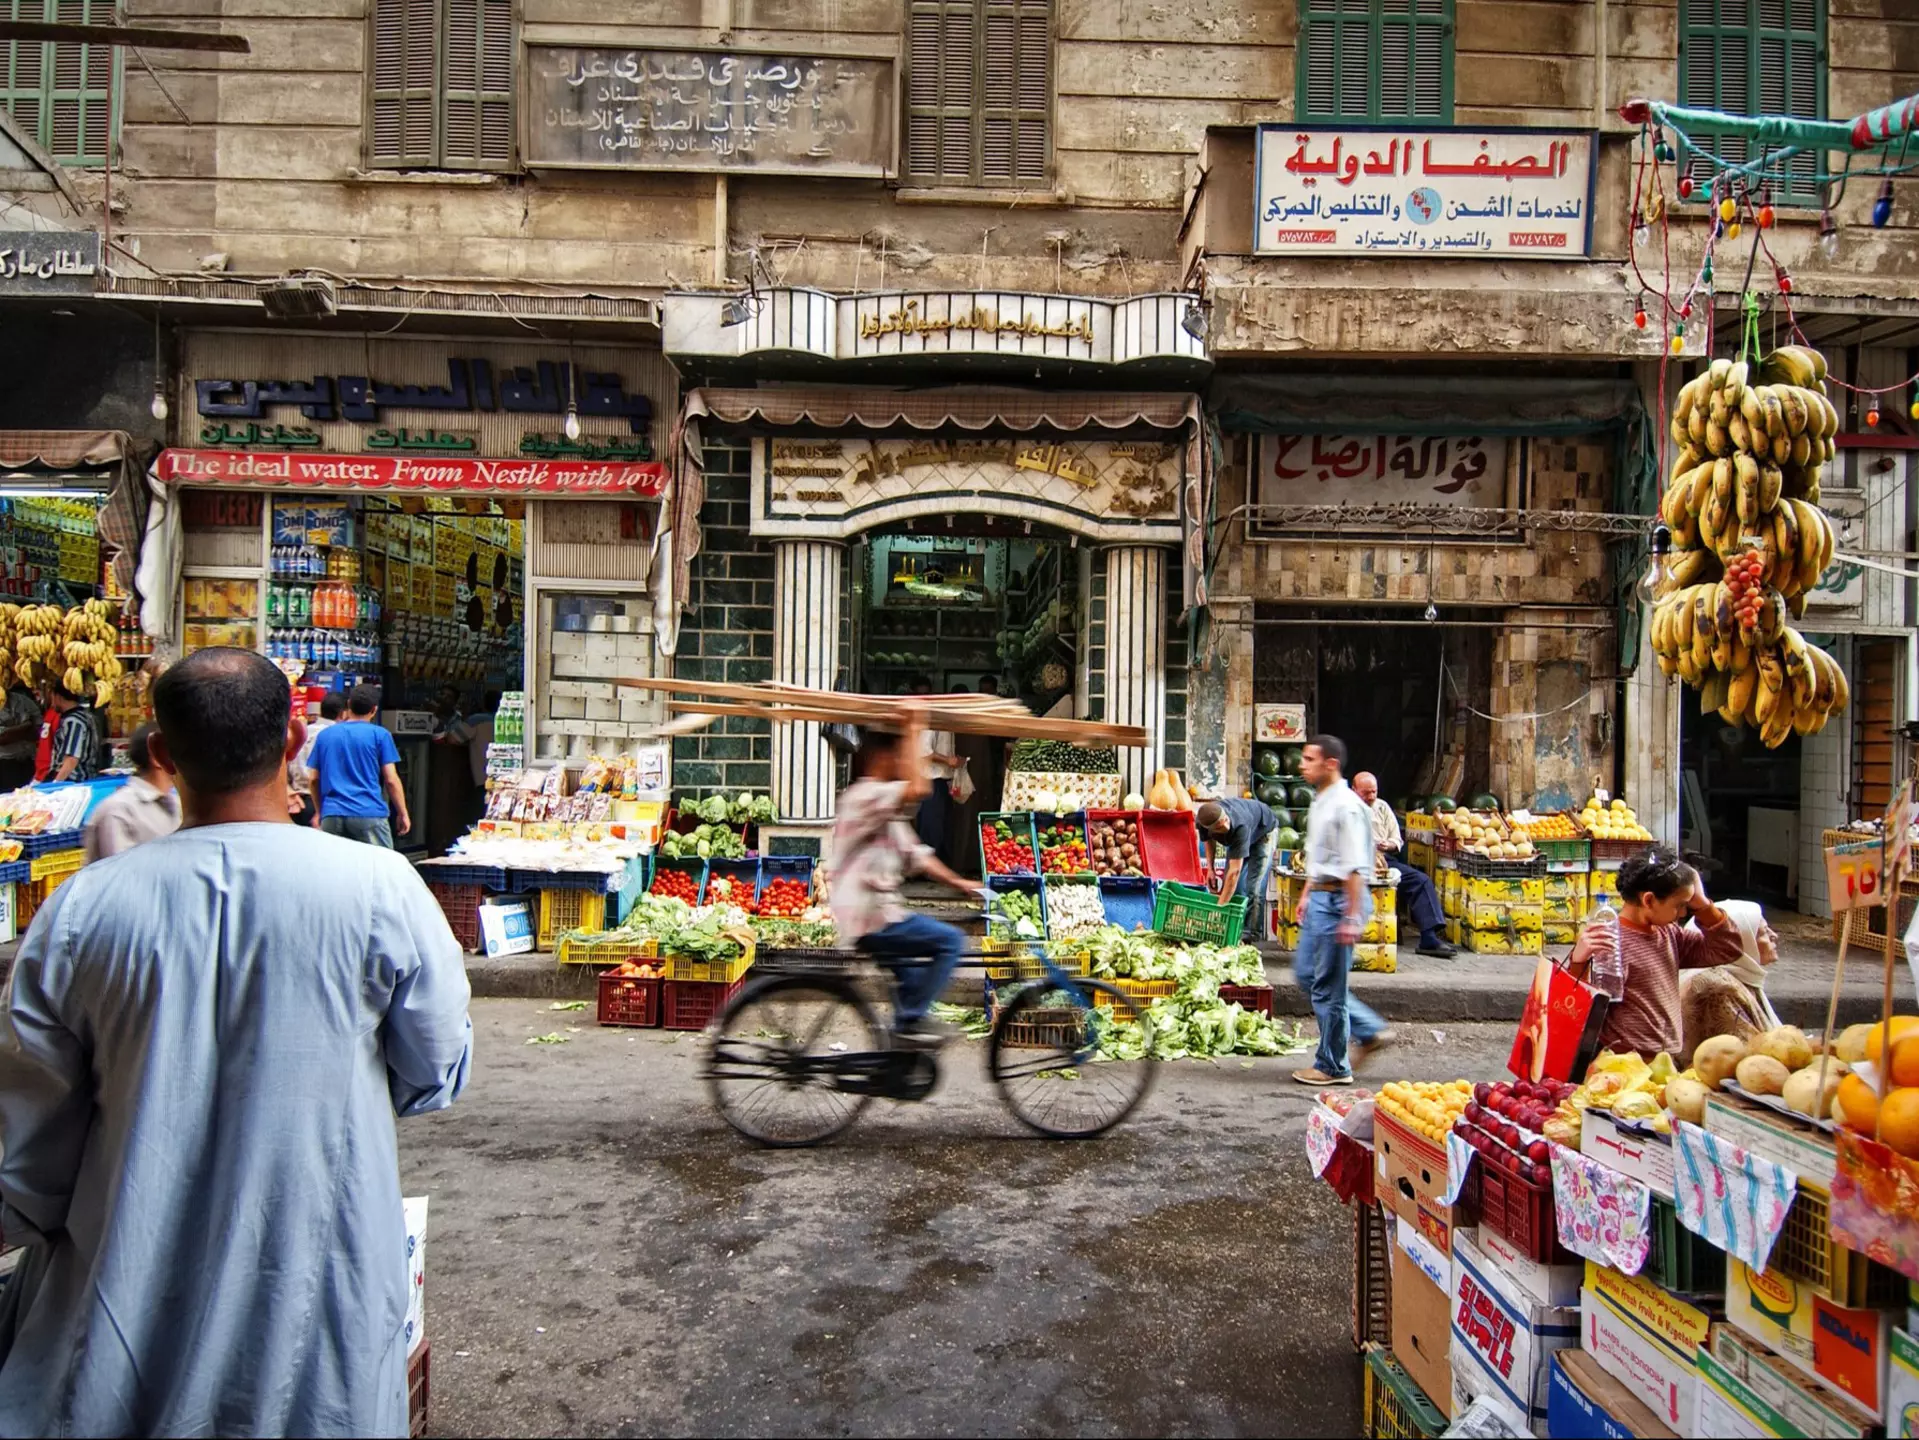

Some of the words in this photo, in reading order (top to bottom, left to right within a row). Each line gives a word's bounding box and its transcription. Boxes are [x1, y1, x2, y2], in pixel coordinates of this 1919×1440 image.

[1284, 134, 1414, 187] الدولية
[1421, 138, 1569, 183] الصفا
[1321, 194, 1401, 222] والتخليص
[1446, 194, 1513, 221] الشحن
[1516, 196, 1582, 219] لخدمات
[37, 249, 95, 279] سلطان
[166, 453, 220, 475] The
[227, 455, 290, 478] ideal
[298, 461, 380, 480] water.
[389, 459, 464, 482] From
[472, 461, 550, 485] Nestlé
[555, 465, 612, 487] with
[283, 515, 304, 528] OM
[314, 517, 340, 528] OMO
